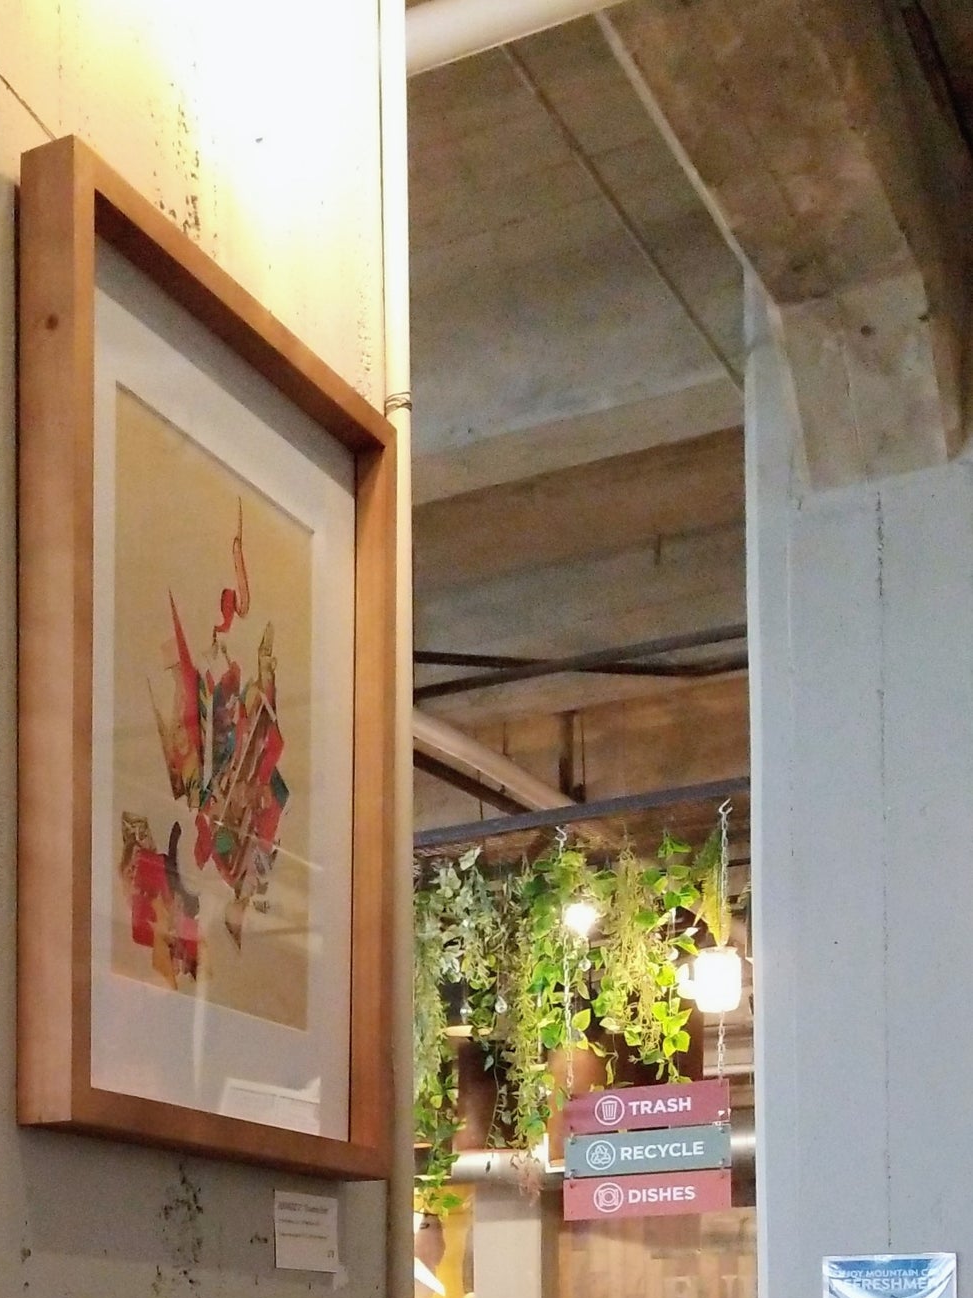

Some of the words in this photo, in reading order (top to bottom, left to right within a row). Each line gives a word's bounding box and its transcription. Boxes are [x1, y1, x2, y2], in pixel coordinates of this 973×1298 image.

[628, 1096, 692, 1116] TRASH
[619, 1140, 705, 1161] RECYCLE
[627, 1185, 696, 1204] DISHES
[865, 1268, 919, 1278] MOUNTAIN
